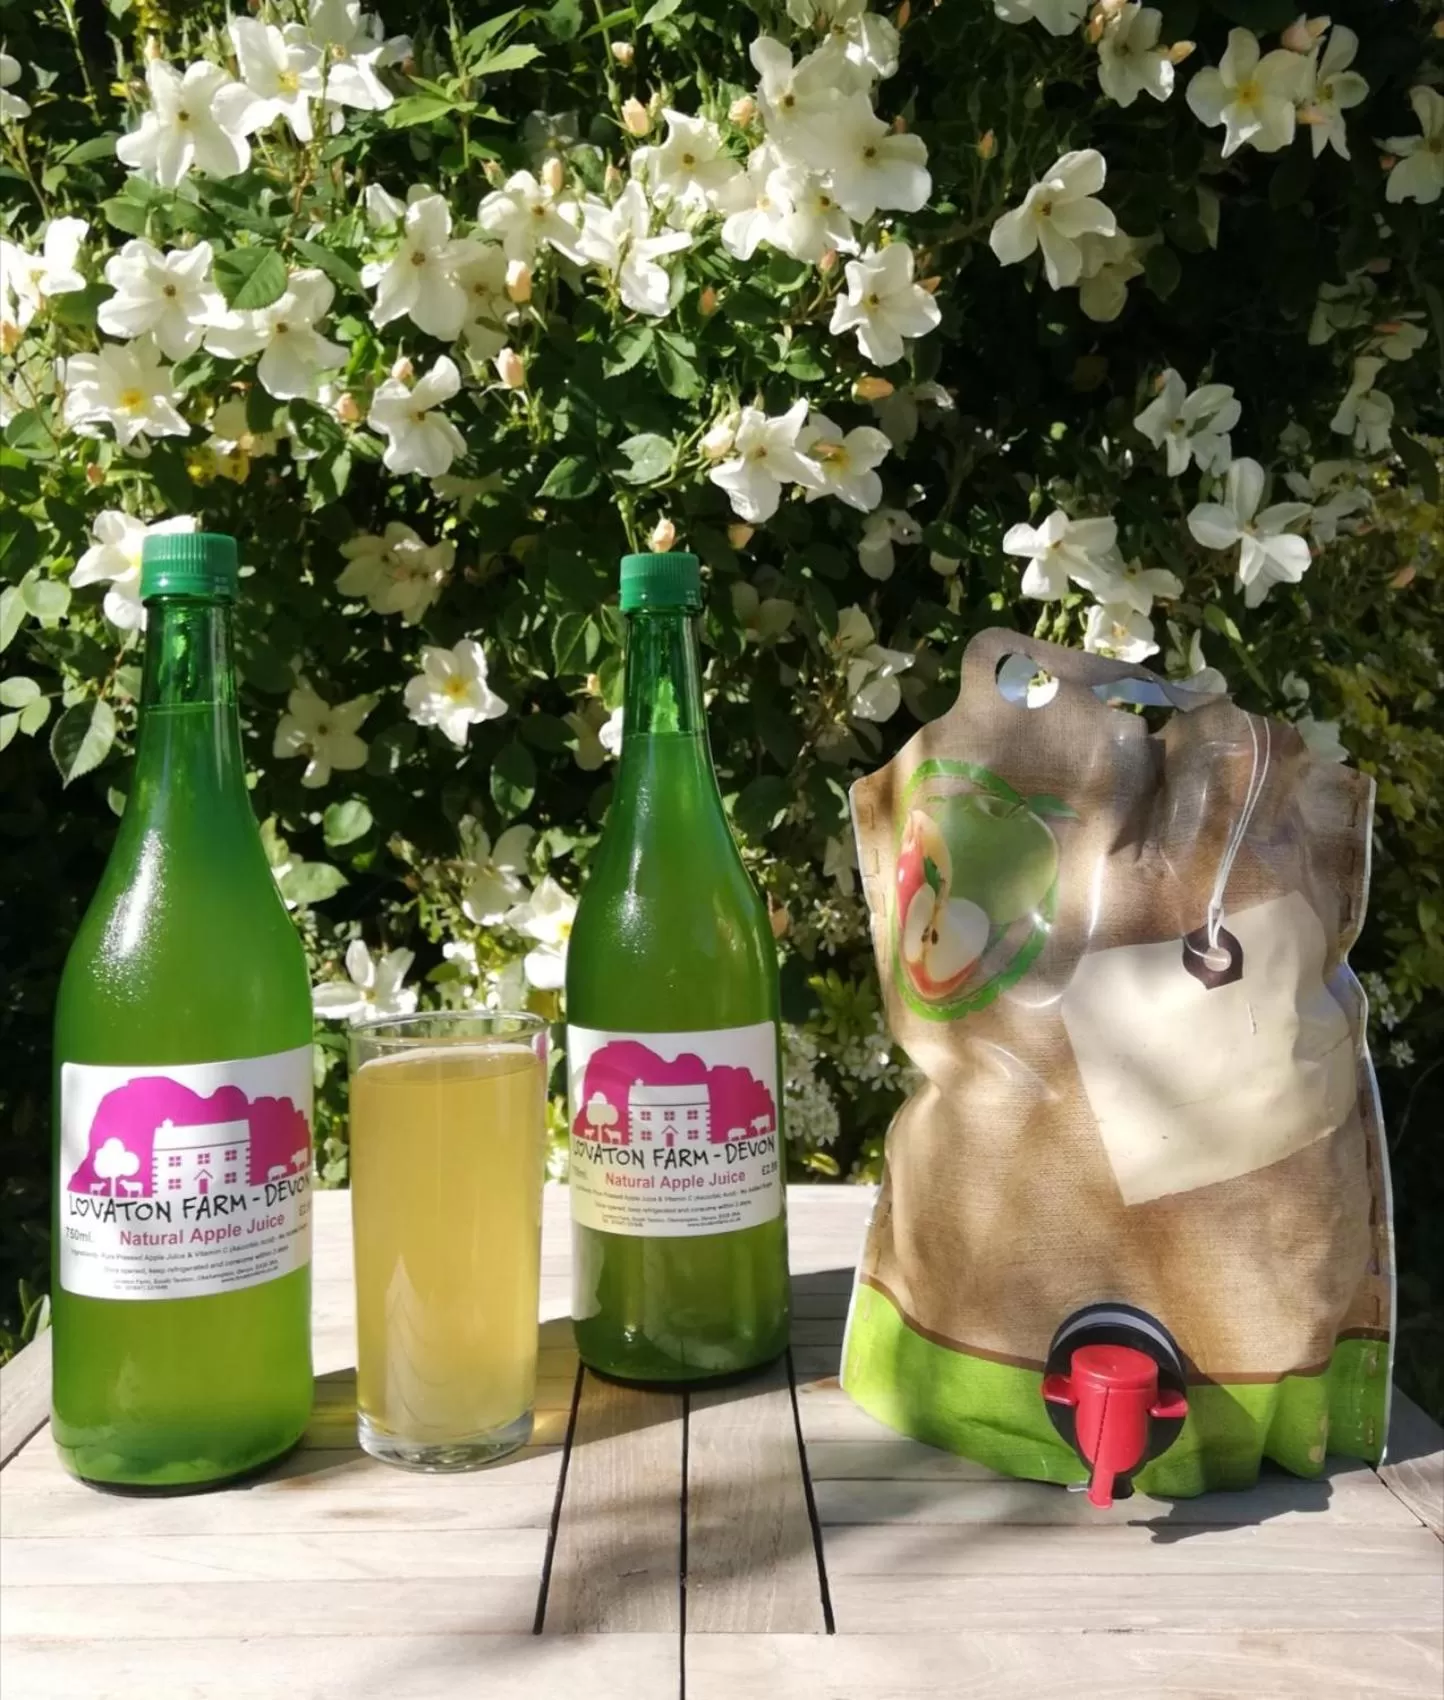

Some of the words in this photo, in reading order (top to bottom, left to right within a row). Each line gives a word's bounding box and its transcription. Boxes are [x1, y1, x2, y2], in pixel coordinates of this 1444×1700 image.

[653, 1148, 710, 1170] FARM
[725, 1136, 776, 1165] DEVON
[182, 1194, 247, 1222] FARM
[264, 1172, 311, 1207] DEVON
[605, 1172, 655, 1189] Natural
[659, 1174, 704, 1192] Apple
[708, 1171, 746, 1187] Juice
[119, 1229, 184, 1247] Natural
[188, 1223, 242, 1245] Apple
[247, 1213, 286, 1234] Juice
